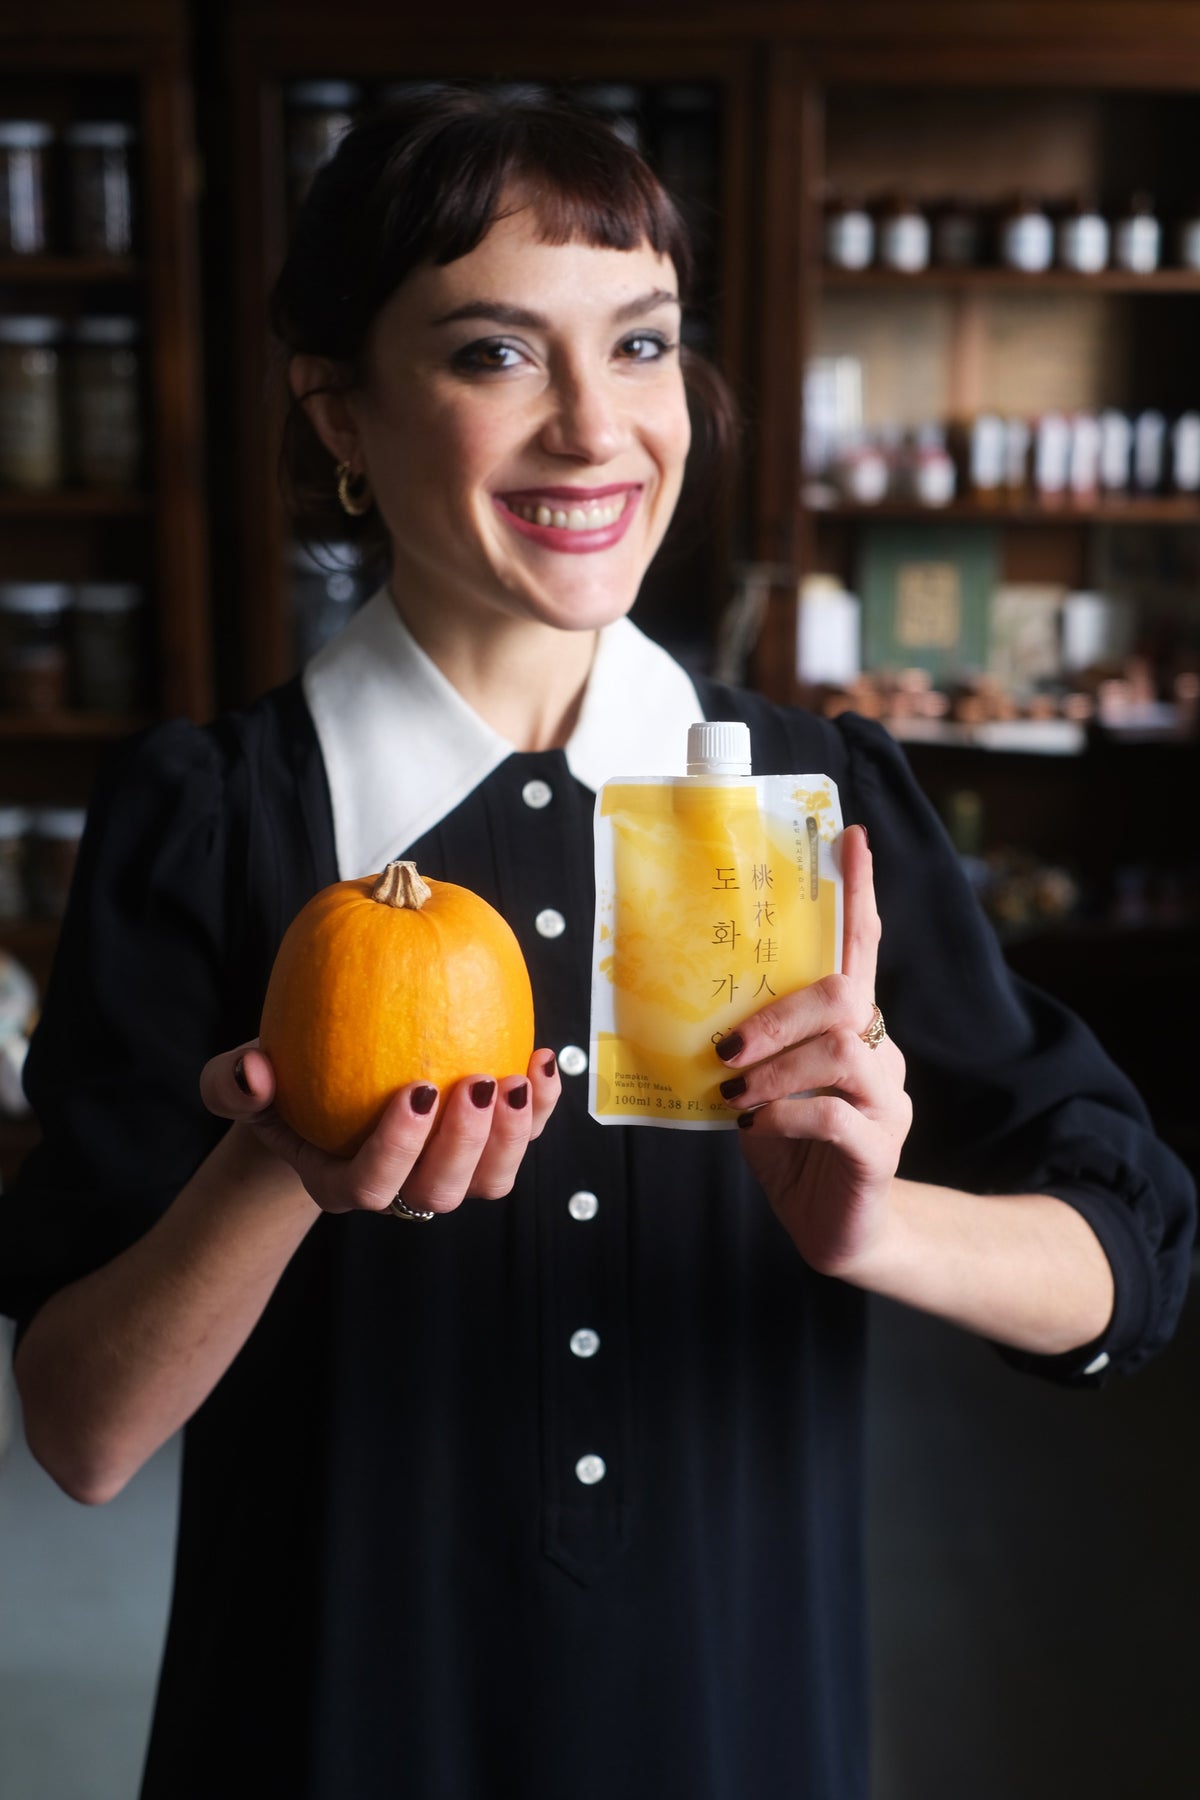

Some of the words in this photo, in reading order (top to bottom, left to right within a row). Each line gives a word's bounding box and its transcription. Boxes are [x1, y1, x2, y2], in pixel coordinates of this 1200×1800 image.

[752, 863, 778, 999] 桃花佳人
[614, 1072, 649, 1081] Pumpkin
[614, 1080, 635, 1088] Wash
[637, 1081, 651, 1089] Off
[653, 1083, 673, 1092] Mask
[615, 1095, 651, 1106] 100ml
[655, 1098, 682, 1110] 3.38
[687, 1100, 703, 1111] Fl.
